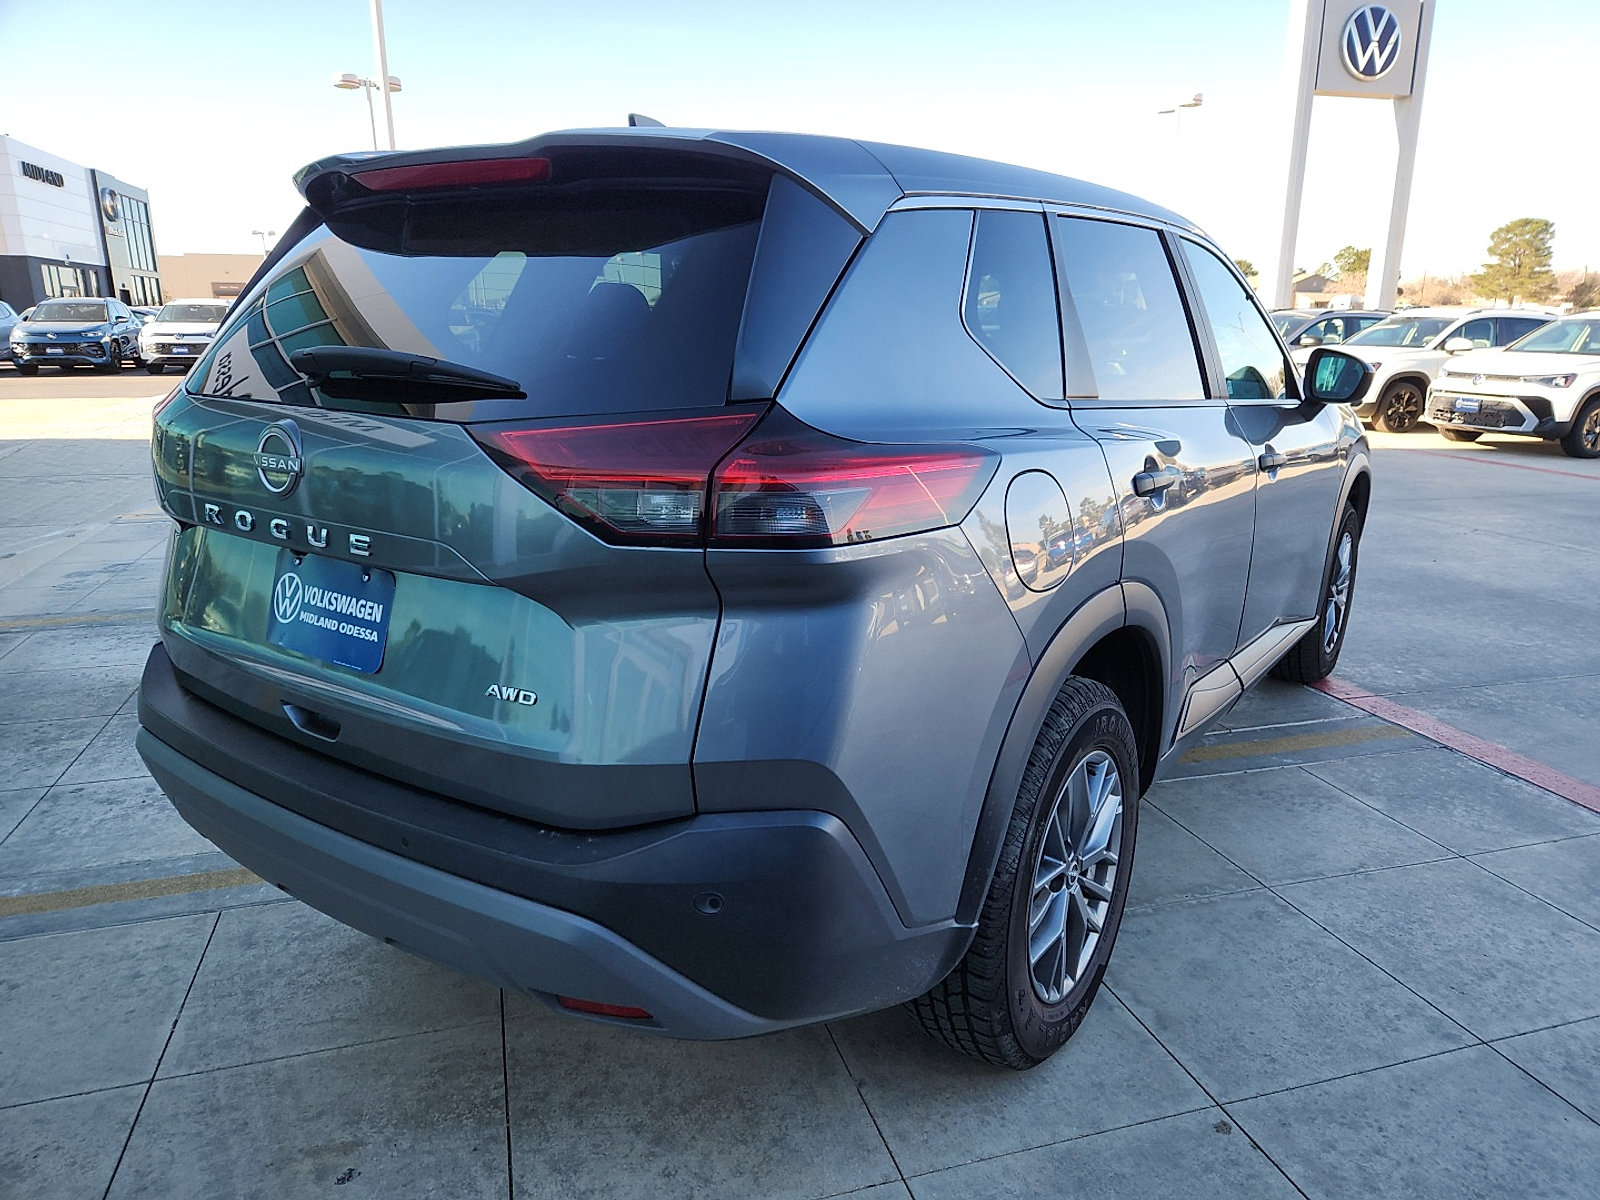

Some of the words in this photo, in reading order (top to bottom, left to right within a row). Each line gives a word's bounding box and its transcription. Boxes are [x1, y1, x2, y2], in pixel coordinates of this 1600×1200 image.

[204, 503, 373, 557] ROGUE
[304, 585, 383, 623] VOLKSWAGEN
[299, 610, 338, 631] MIDLAND
[338, 622, 378, 643] ODESSA
[485, 684, 537, 705] AWD
